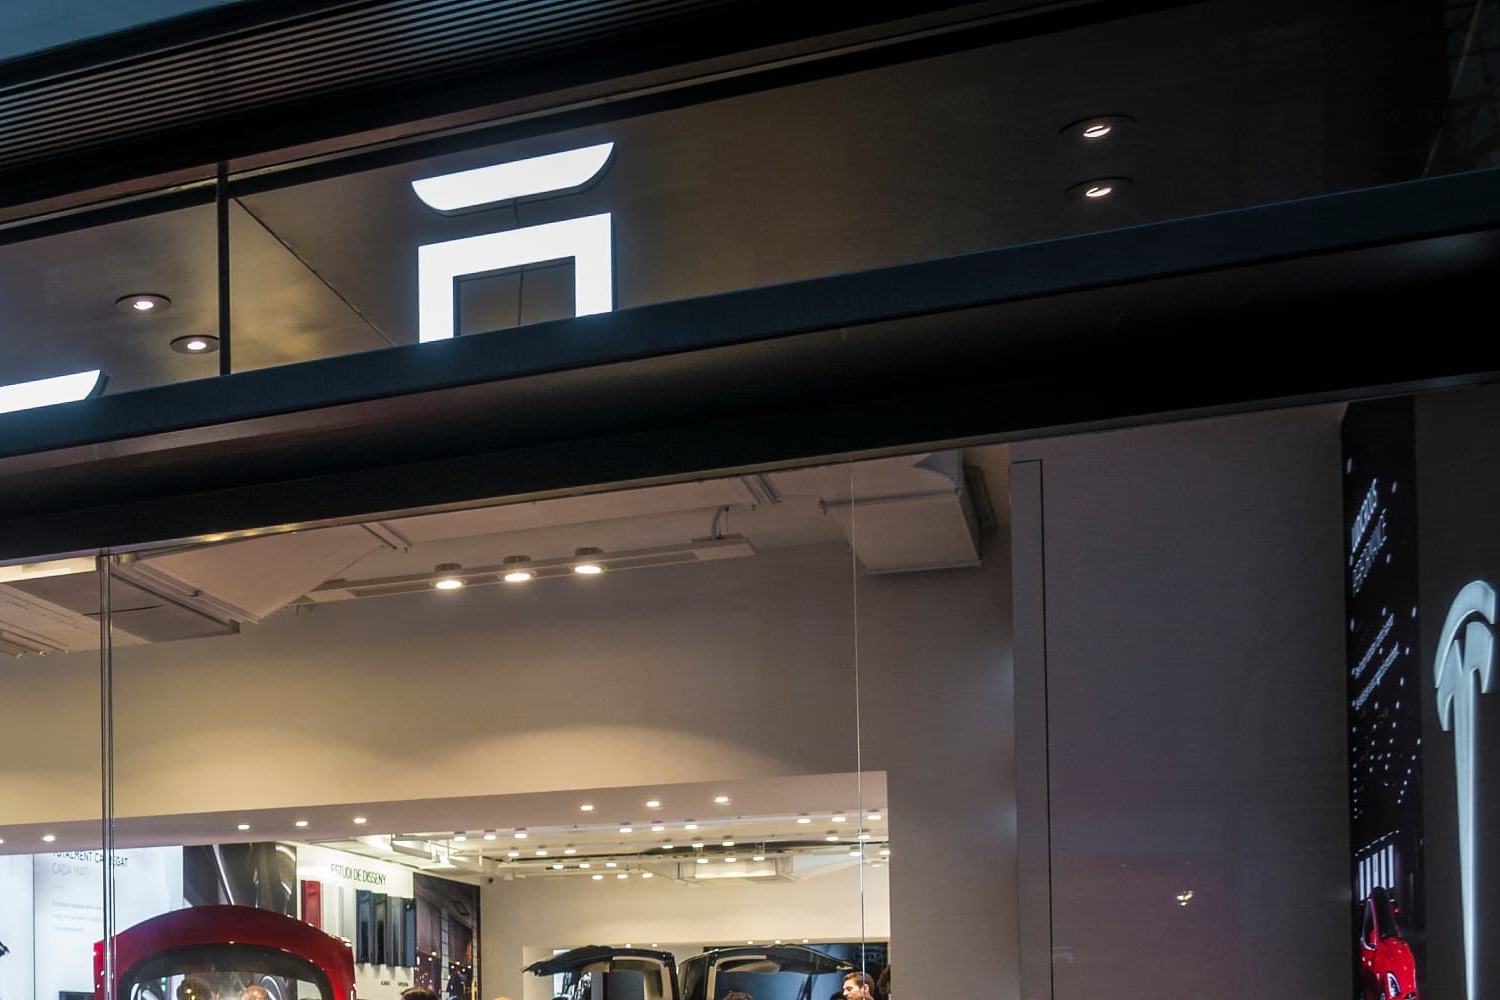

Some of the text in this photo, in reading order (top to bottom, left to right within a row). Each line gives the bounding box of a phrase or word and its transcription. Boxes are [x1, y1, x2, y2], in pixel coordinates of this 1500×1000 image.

[94, 852, 129, 867] CAEGAT
[330, 863, 387, 885] ESTUDI DE DISSENY
